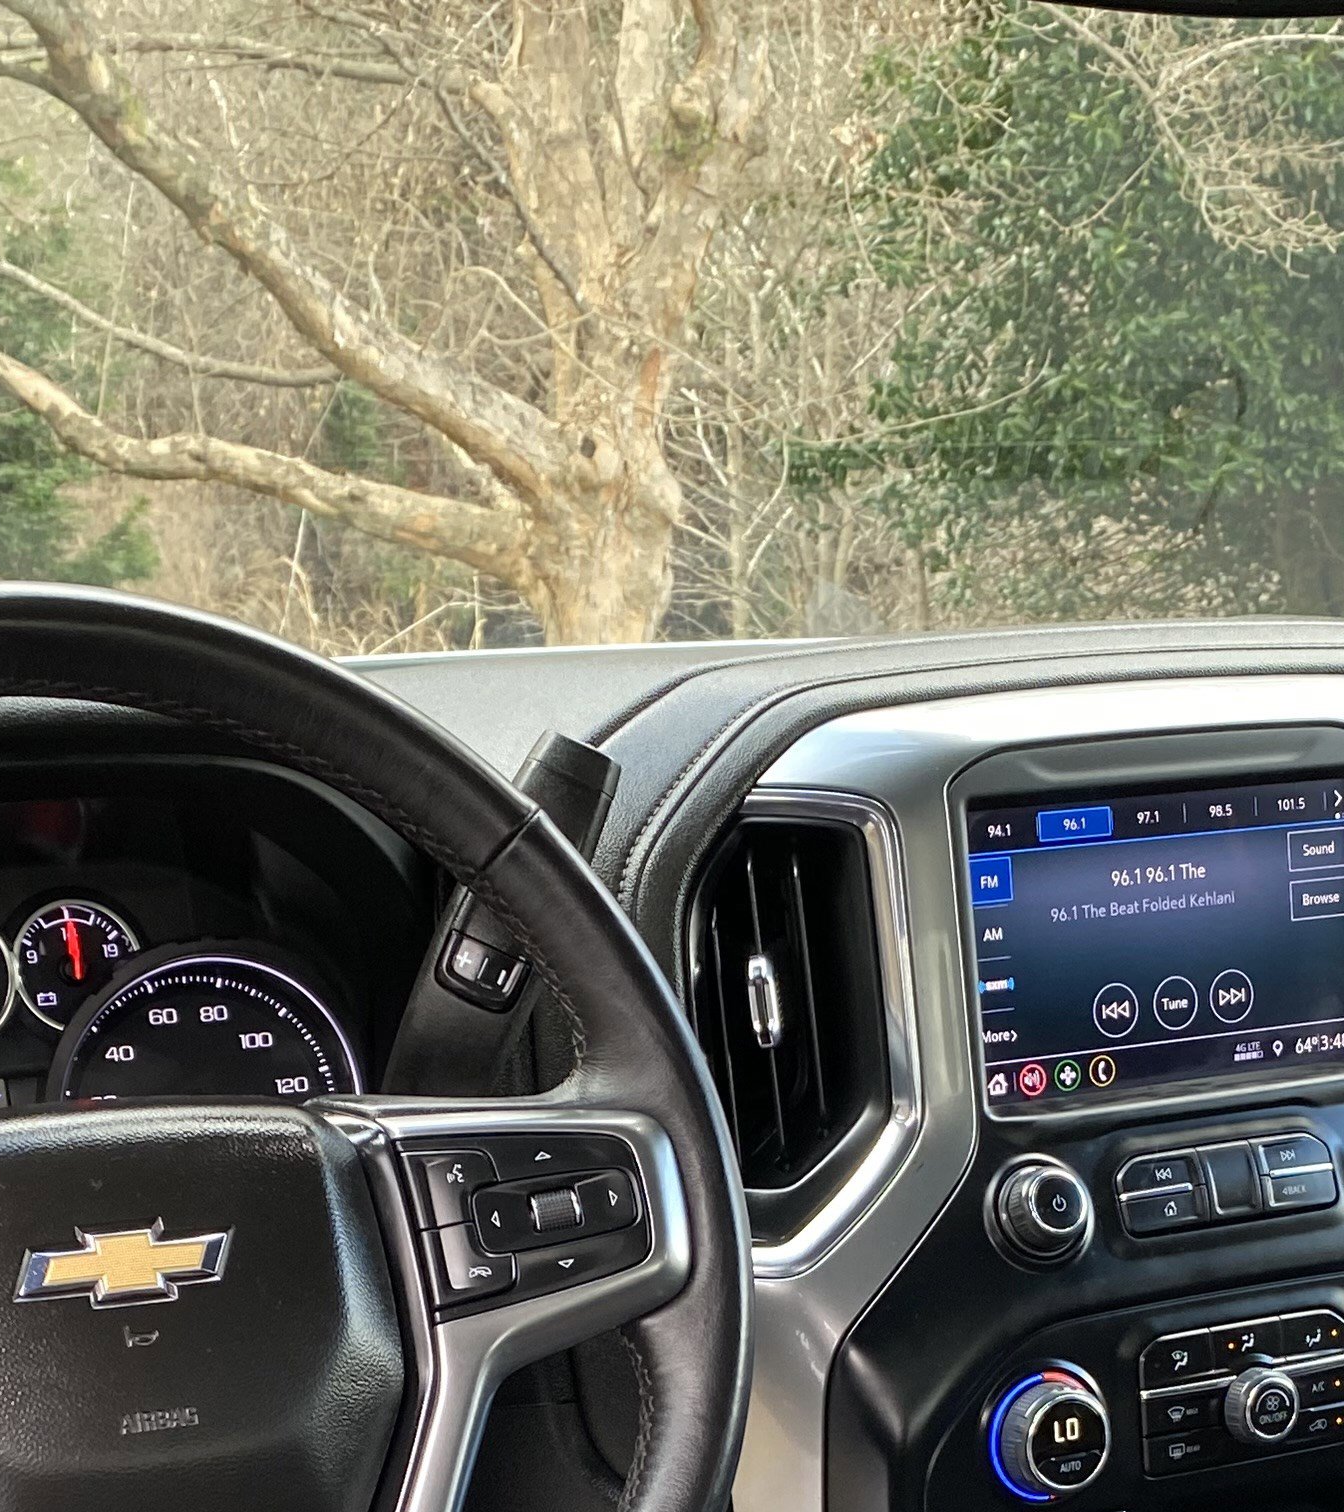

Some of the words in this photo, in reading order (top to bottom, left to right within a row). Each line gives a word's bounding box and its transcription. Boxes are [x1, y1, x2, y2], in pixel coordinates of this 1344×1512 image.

[1209, 804, 1233, 818] 98.5
[1277, 798, 1305, 811] 101.5
[1063, 817, 1086, 830] 96.1
[1137, 811, 1160, 824] 97.1
[987, 824, 1011, 838] 94.1
[1302, 841, 1335, 856] Sound
[1111, 868, 1141, 886] 96.1
[1146, 865, 1175, 883] 96.1
[1179, 863, 1206, 879] The
[980, 875, 999, 889] FM
[1302, 892, 1340, 905] Browse
[1050, 906, 1078, 922] 96.1
[1082, 903, 1106, 919] The
[1110, 901, 1139, 916] Beat
[1143, 896, 1186, 912] Folded
[1190, 891, 1235, 907] Kehlani
[982, 927, 1003, 941] AM
[26, 950, 38, 964] 9
[102, 943, 118, 958] 19
[986, 979, 1008, 991] sxm
[1161, 998, 1188, 1010] Tune
[148, 1008, 178, 1025] 60
[199, 1005, 228, 1022] 80
[239, 1032, 273, 1049] 100
[1235, 1042, 1246, 1052] 4G
[1247, 1041, 1260, 1051] LTE
[105, 1045, 134, 1062] 40
[274, 1076, 308, 1094] 120
[1311, 1381, 1325, 1393] A/C
[120, 1407, 199, 1435] AIRBAG
[1259, 1411, 1288, 1425] ON/OFF
[1053, 1417, 1079, 1443] LO
[1059, 1460, 1081, 1473] AUTO
